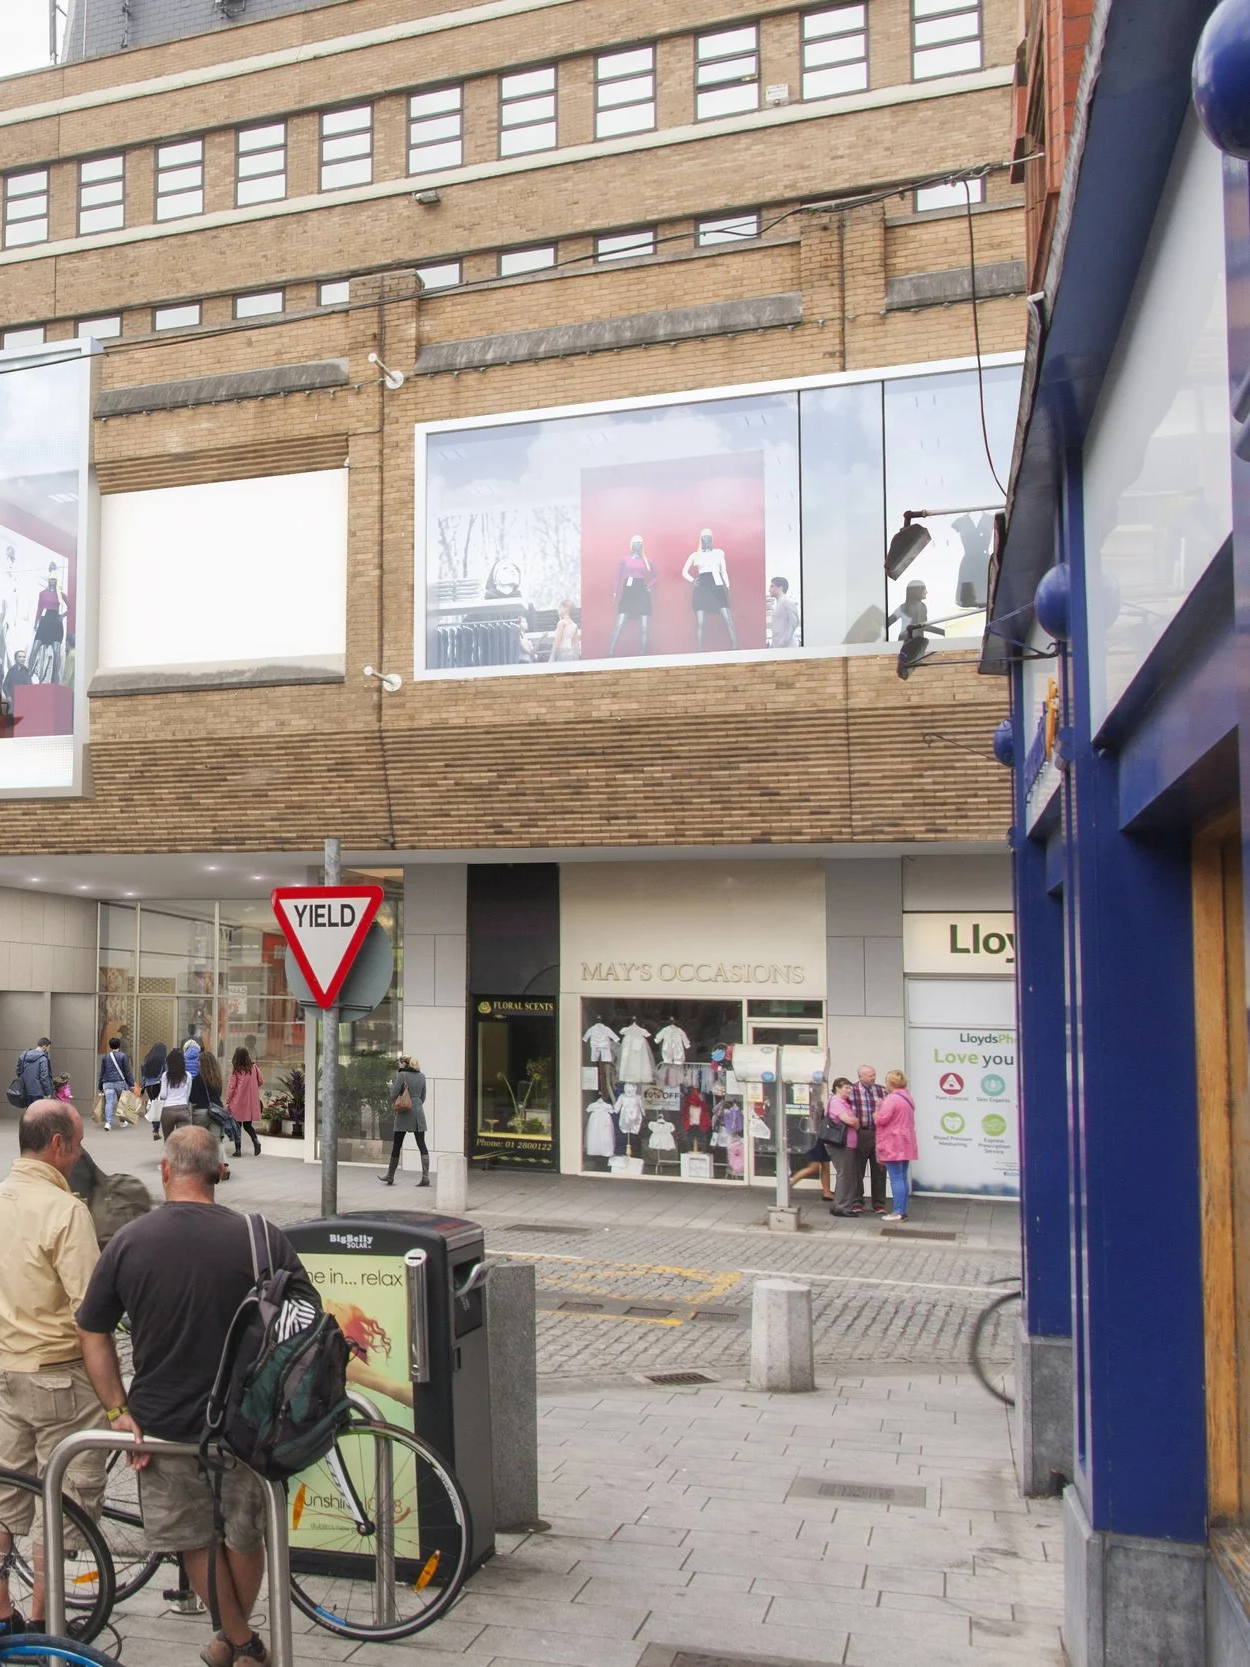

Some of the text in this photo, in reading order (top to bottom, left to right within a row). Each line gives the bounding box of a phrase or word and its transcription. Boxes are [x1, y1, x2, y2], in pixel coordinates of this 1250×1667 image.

[293, 903, 355, 929] YIELD
[580, 962, 806, 984] MAY'S OCCASIONS
[493, 1001, 554, 1011] FLORAL SCENTS
[959, 1032, 1016, 1046] LloydsPh
[933, 1048, 979, 1065] Love
[476, 1138, 504, 1148] Phone:
[505, 1140, 515, 1149] 01
[329, 1234, 374, 1244] BigBelly
[329, 1267, 357, 1285] in...
[361, 1269, 404, 1287] relax
